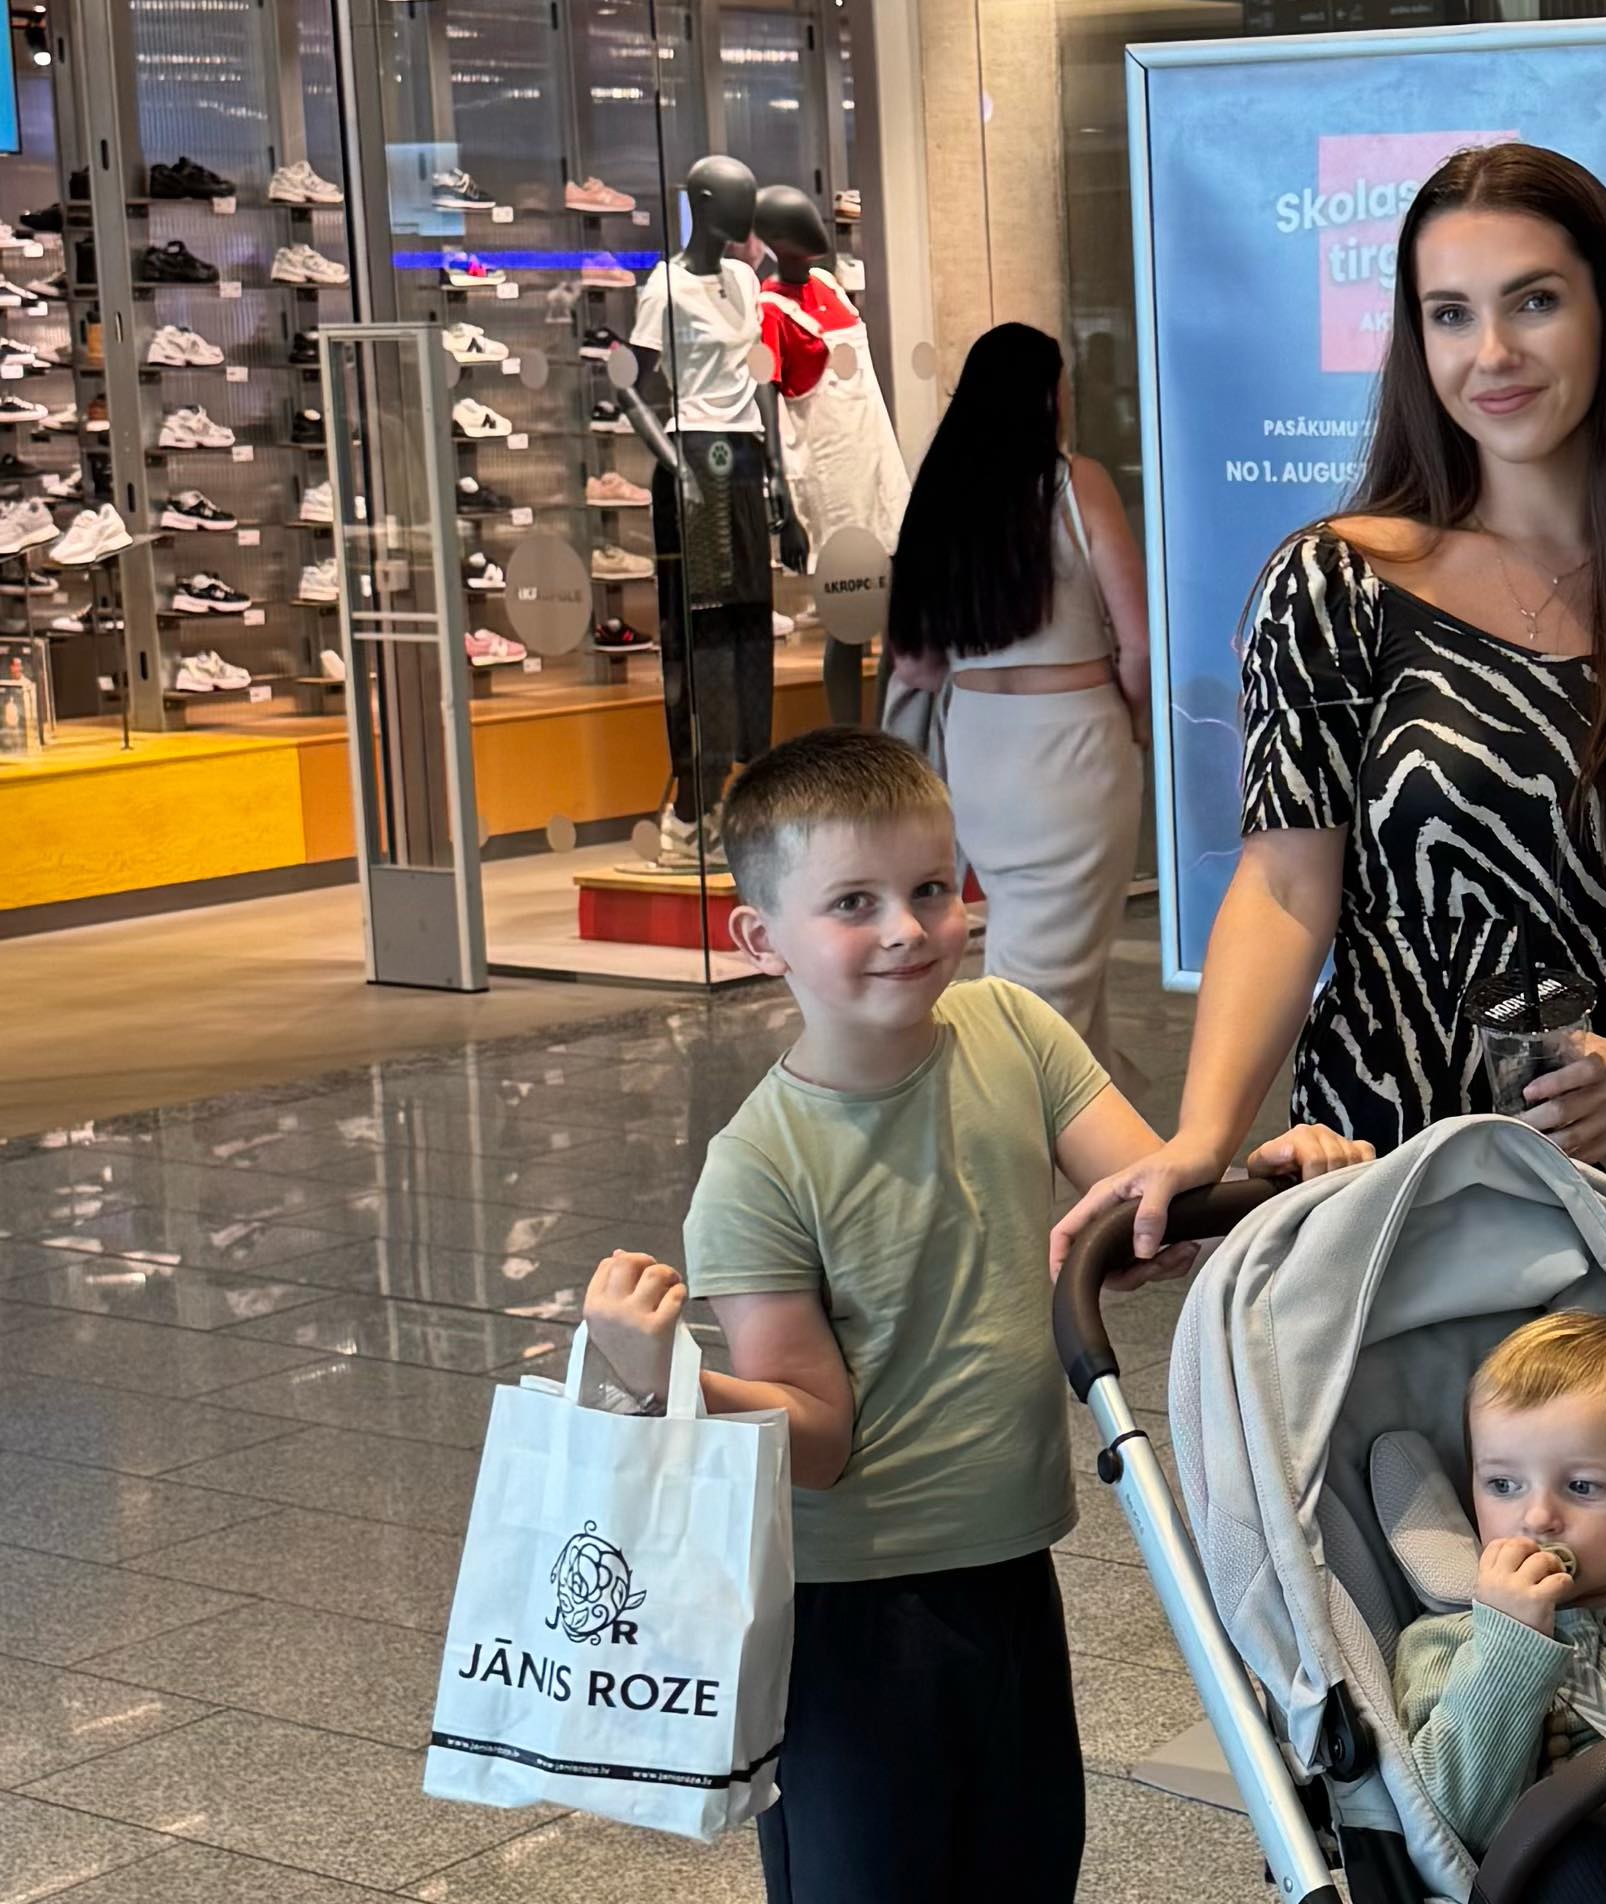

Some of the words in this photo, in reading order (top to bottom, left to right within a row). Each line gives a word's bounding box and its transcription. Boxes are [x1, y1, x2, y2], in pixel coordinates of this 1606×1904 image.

[1263, 416, 1359, 437] PASĀKUMU
[1226, 460, 1259, 482] NO
[458, 1637, 572, 1702] JĀNIS
[587, 1669, 720, 1717] ROZE
